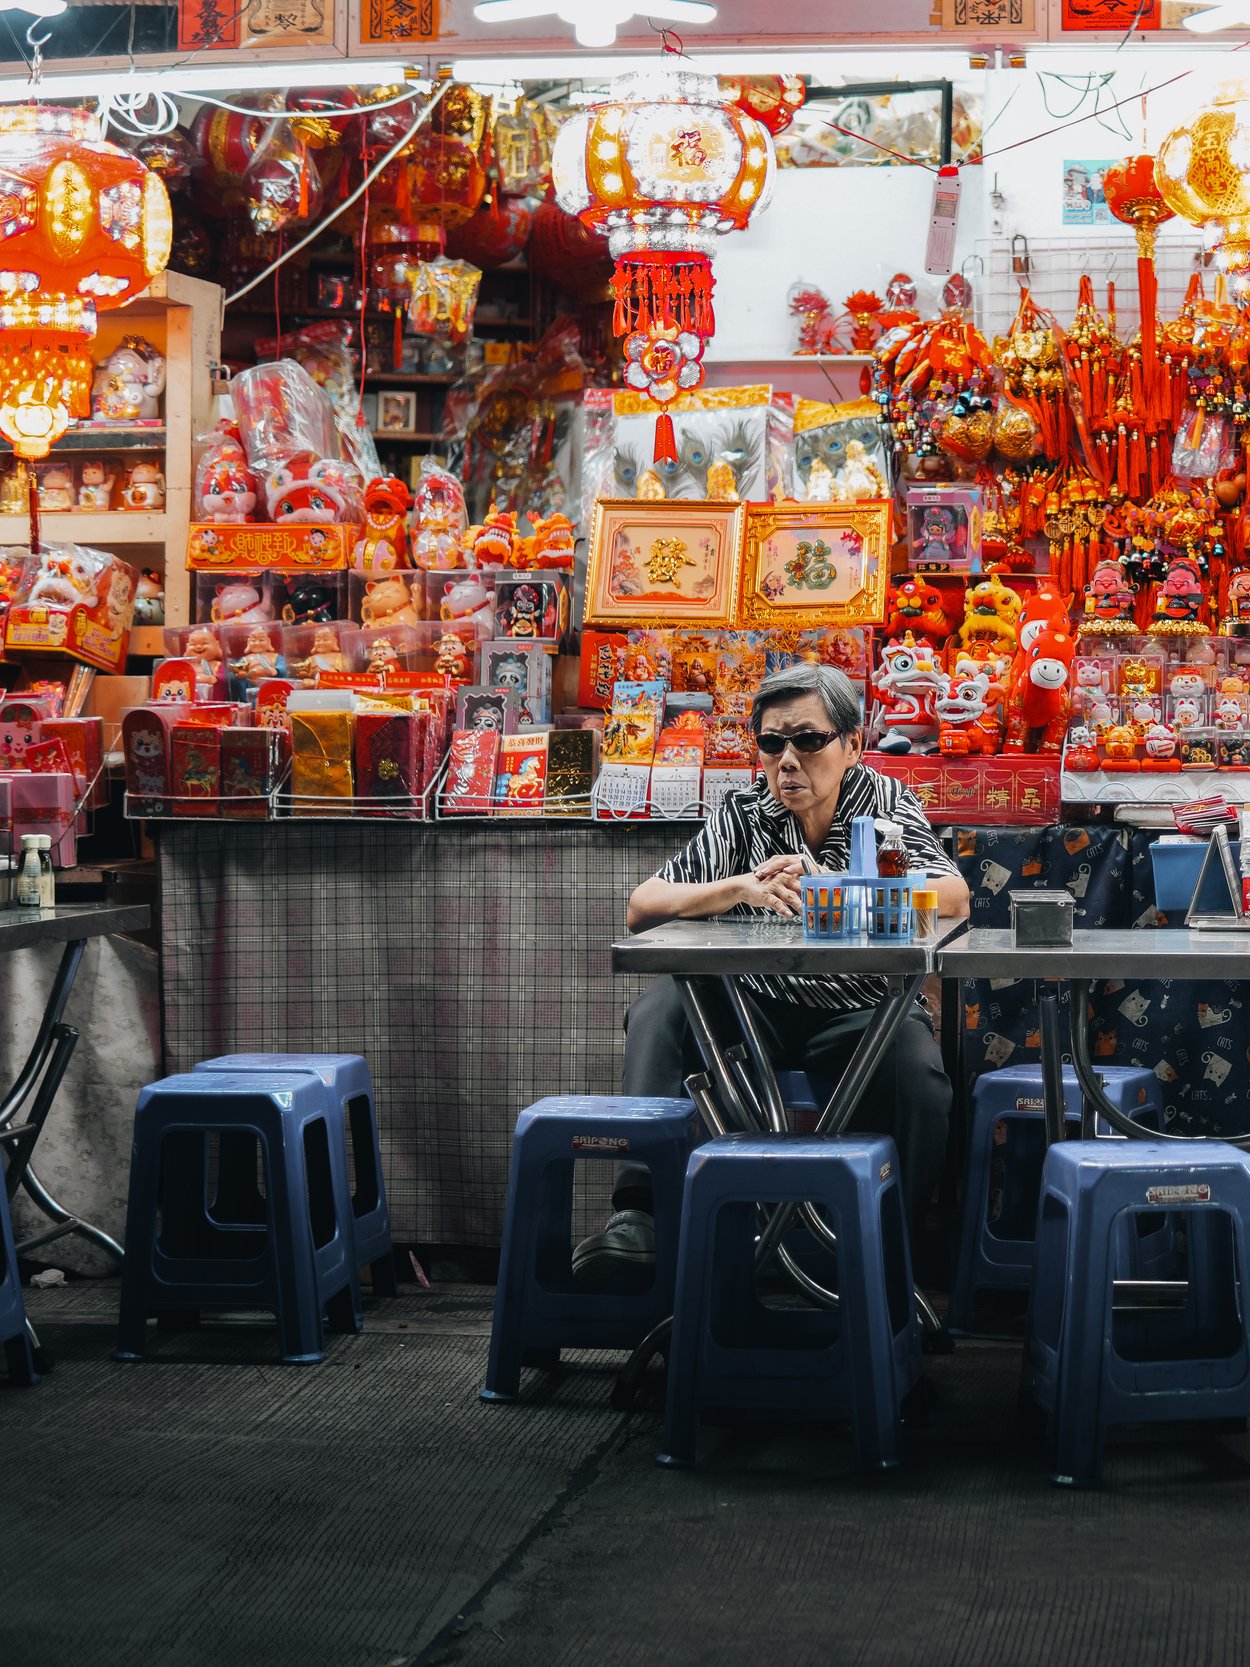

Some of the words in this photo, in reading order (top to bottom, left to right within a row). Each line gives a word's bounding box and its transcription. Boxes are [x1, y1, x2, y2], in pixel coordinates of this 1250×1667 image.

[670, 130, 707, 167] 福
[783, 538, 838, 591] 福
[917, 785, 938, 808] 季
[986, 786, 1042, 809] 精品
[1087, 844, 1104, 858] CATS
[974, 898, 990, 908] CATS
[1132, 1037, 1149, 1052] CATS
[1216, 1035, 1232, 1050] CATS
[1191, 1090, 1208, 1100] CATS
[572, 1135, 629, 1147] SRIPONG
